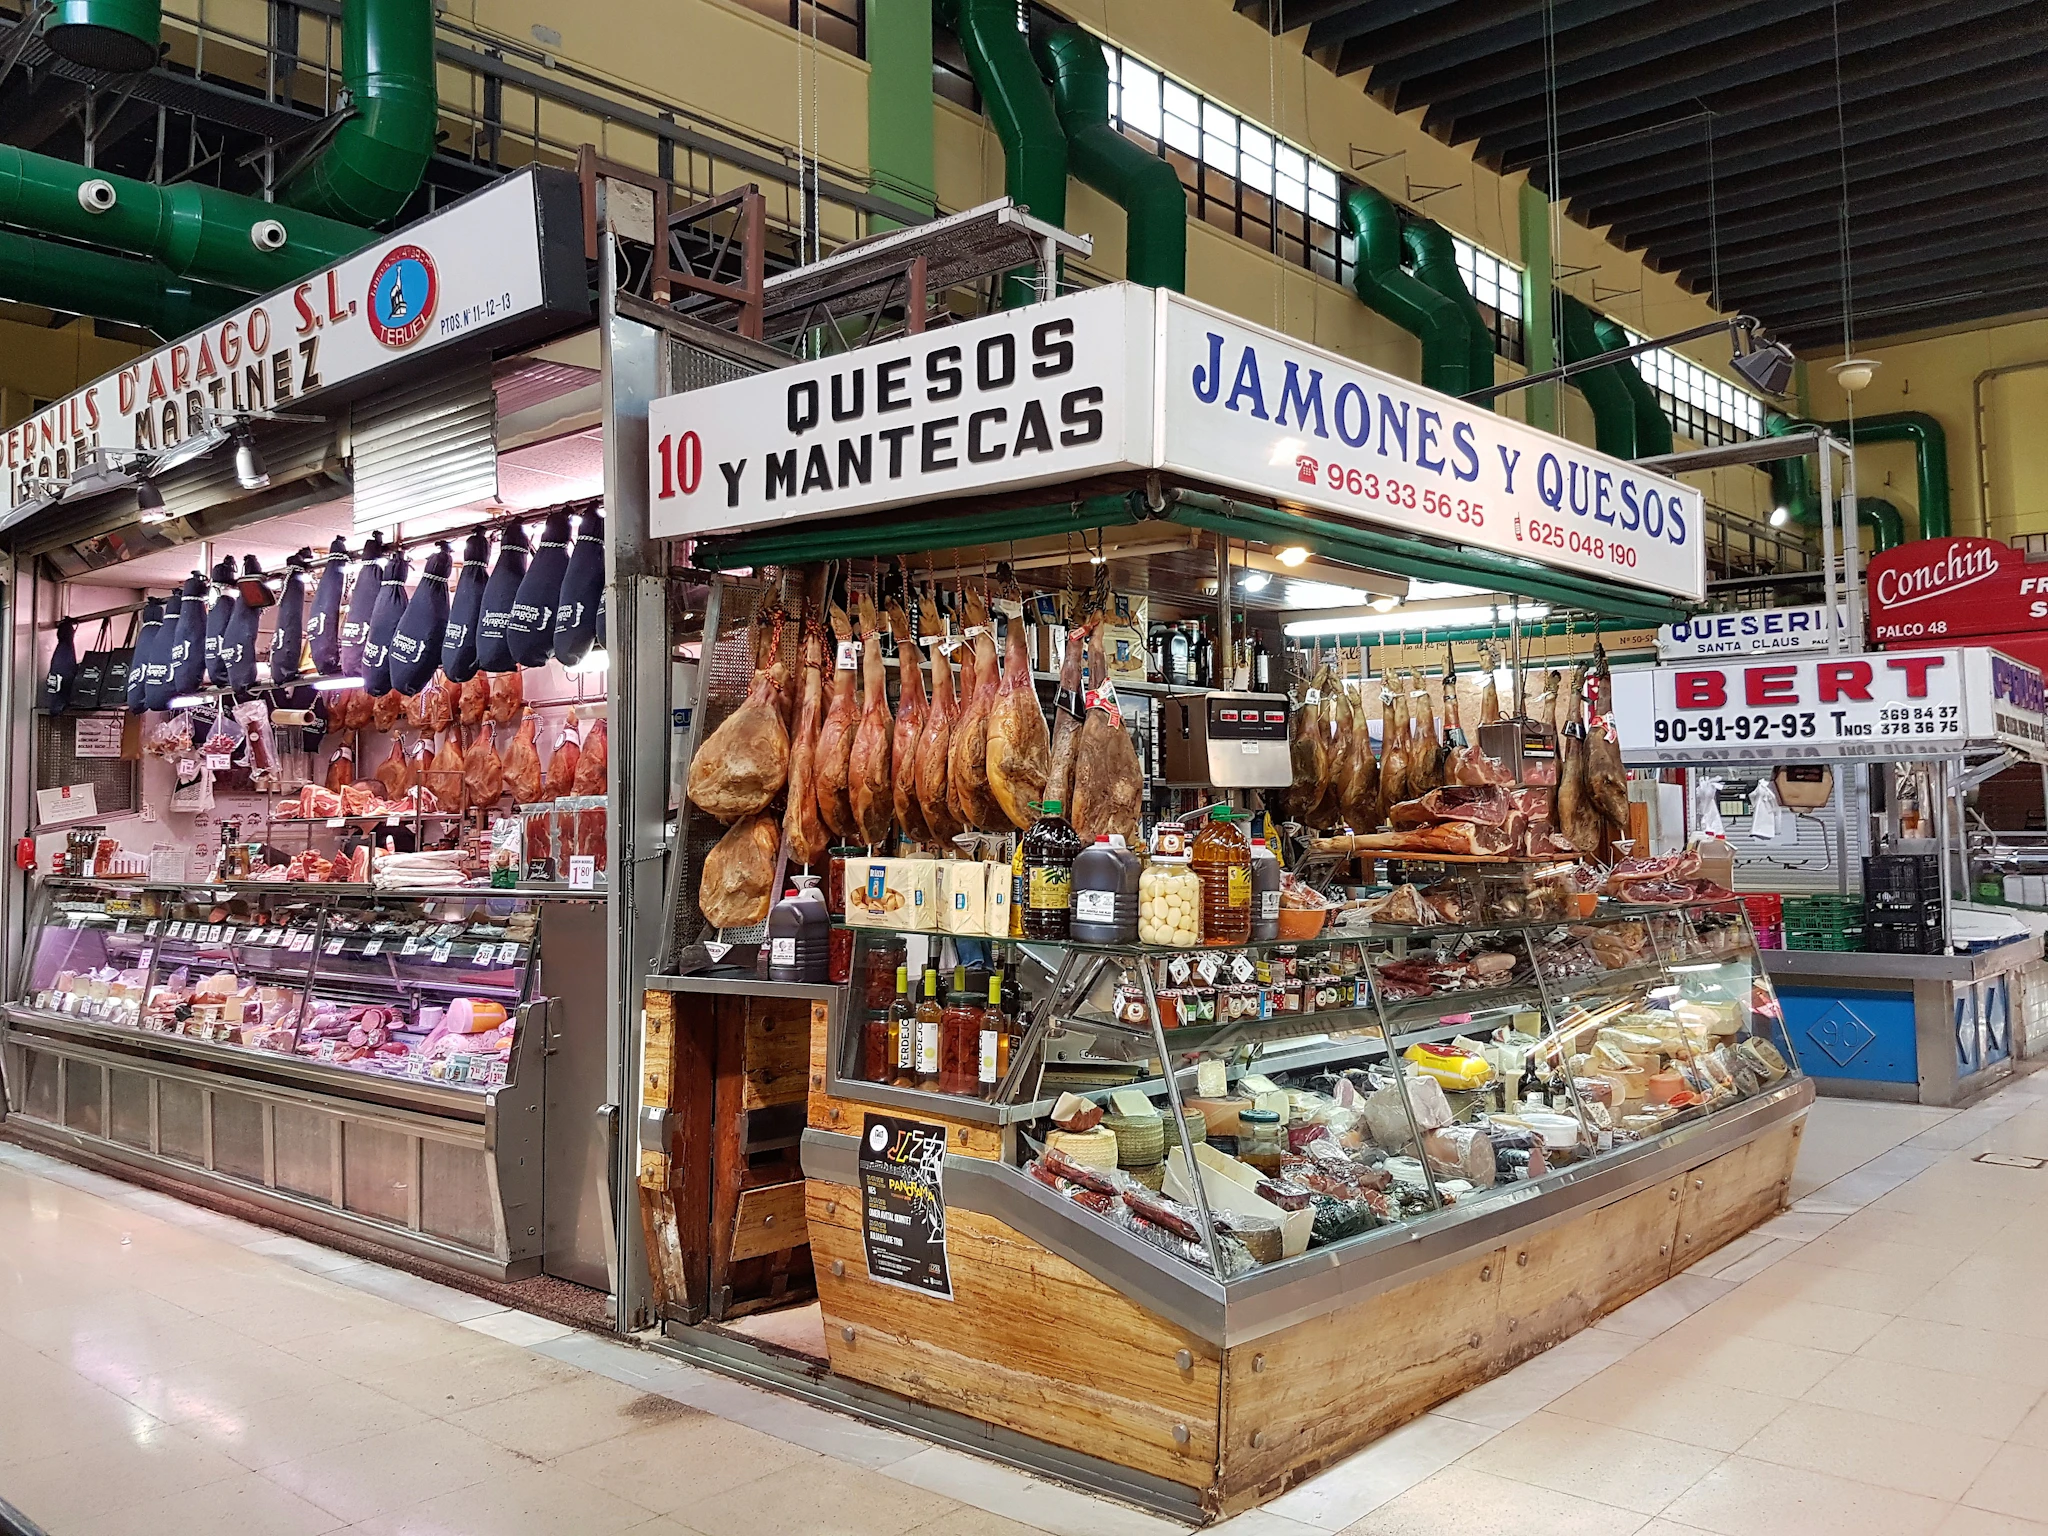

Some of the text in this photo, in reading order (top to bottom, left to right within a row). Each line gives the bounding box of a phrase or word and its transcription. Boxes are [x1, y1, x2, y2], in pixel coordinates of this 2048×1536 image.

[379, 314, 428, 346] TERUEL
[441, 313, 463, 335] PTOS.
[473, 292, 511, 322] 11-12-13
[118, 307, 271, 416] D'ARAGO
[787, 317, 1075, 436] QUESOS
[135, 334, 323, 450] MARTINEZ
[719, 385, 1104, 507] Y MANTECAS
[1192, 331, 1687, 546] JAMONES Y QUESOS
[657, 430, 703, 500] 10
[1327, 463, 1485, 527] 963 33 56 35
[1529, 518, 1637, 568] 625 048 190
[1876, 542, 2000, 605] Conchin
[1697, 641, 1742, 653] SANTA
[1752, 637, 1800, 649] CLAUS
[1876, 620, 1948, 639] PALCO 48
[1674, 656, 1945, 710] BERT
[1655, 711, 1816, 743] 90-91-92-93
[1879, 706, 1958, 721] 369 84 37
[1880, 720, 1958, 735] 378 36 75
[901, 1019, 909, 1068] VERDEJO
[1823, 1020, 1859, 1047] 90
[889, 1179, 935, 1202] PANORAMA
